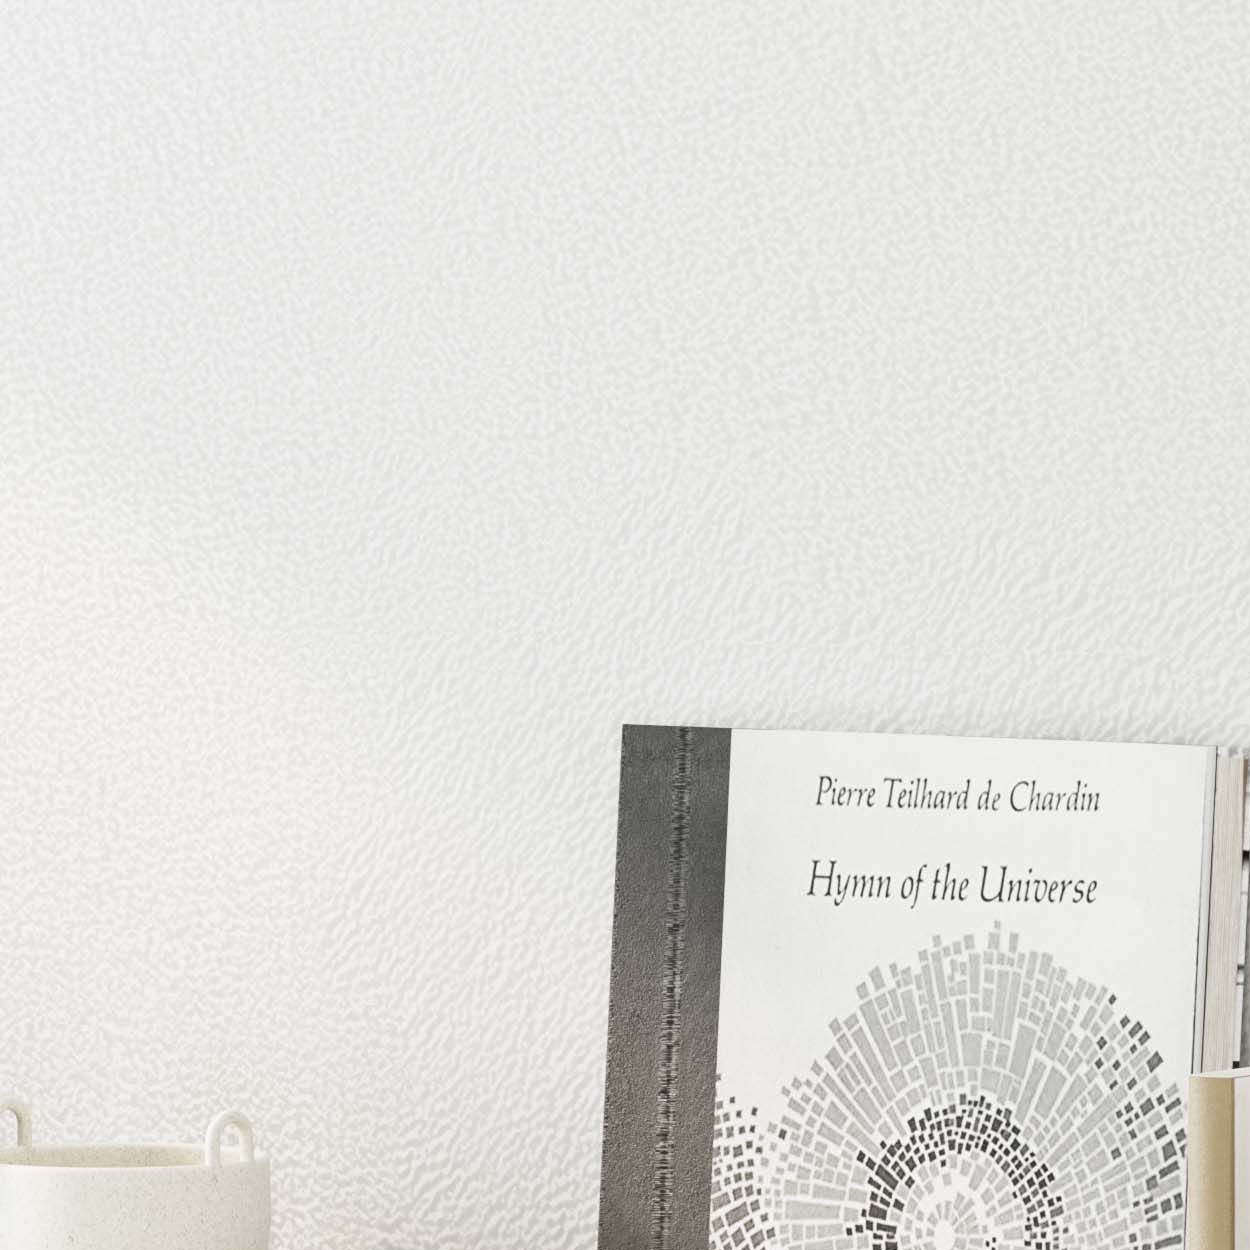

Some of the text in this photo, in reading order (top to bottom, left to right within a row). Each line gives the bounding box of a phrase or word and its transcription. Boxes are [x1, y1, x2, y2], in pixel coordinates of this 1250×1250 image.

[815, 775, 1101, 813] Pierre Teilhard de Chardin
[806, 859, 1099, 909] Hymn of the Universe
